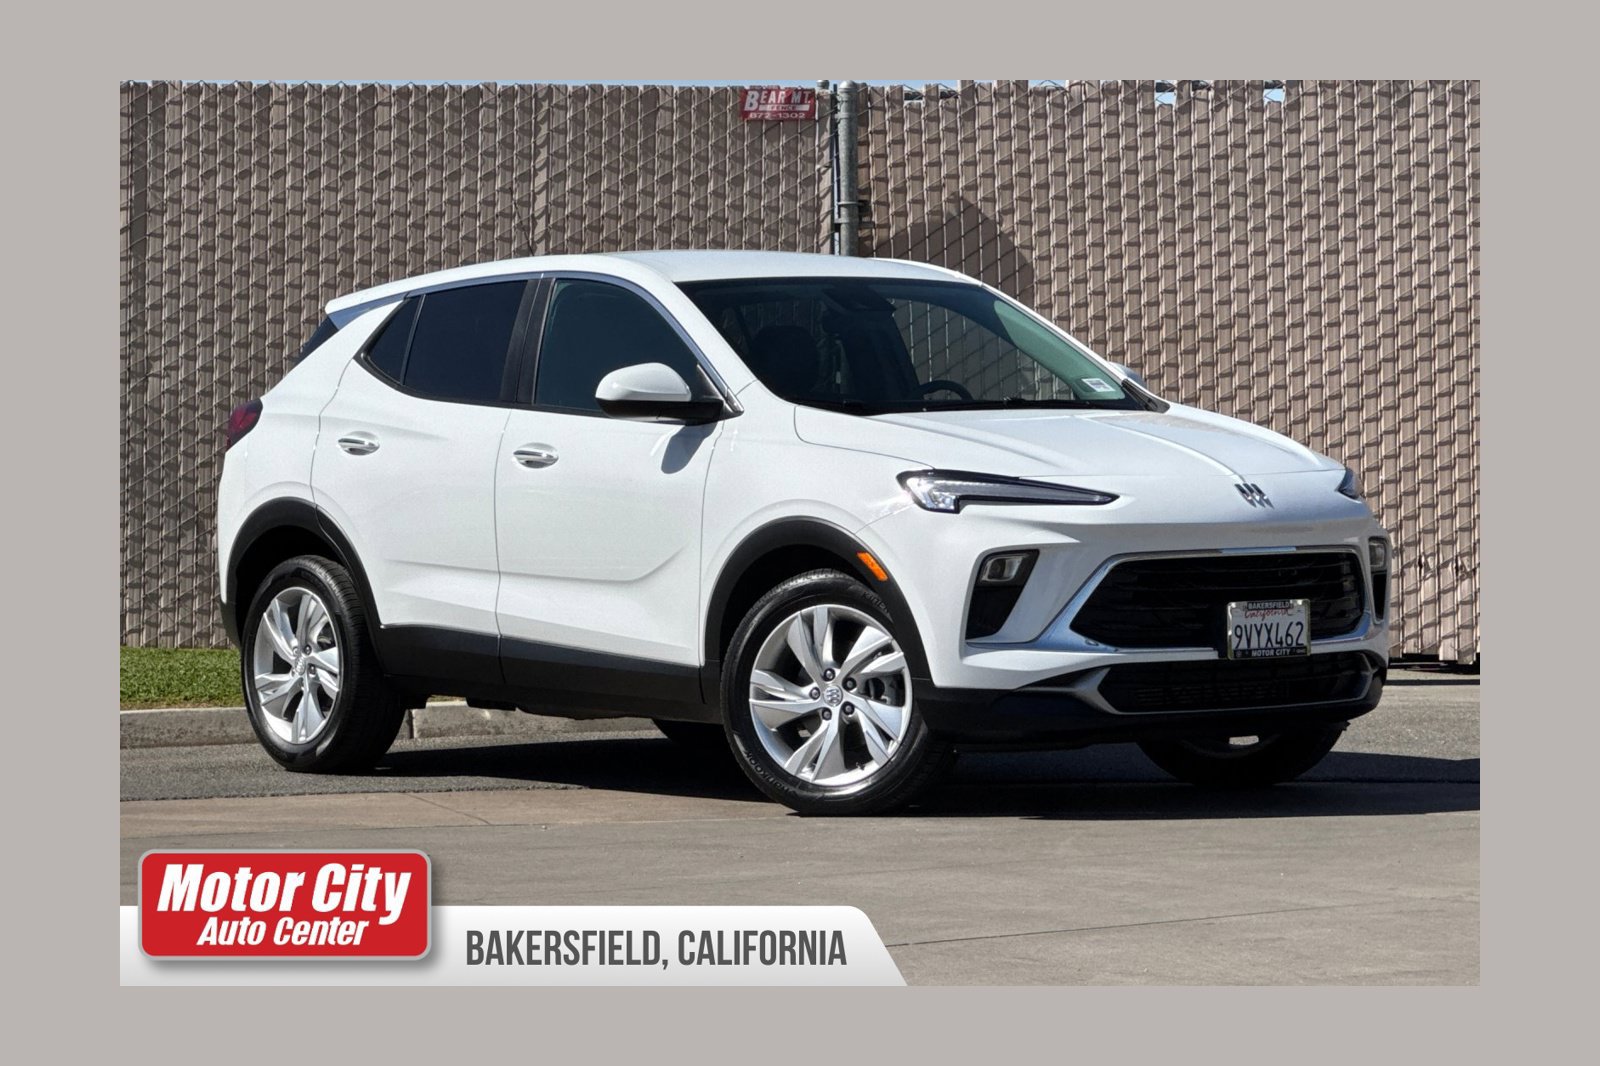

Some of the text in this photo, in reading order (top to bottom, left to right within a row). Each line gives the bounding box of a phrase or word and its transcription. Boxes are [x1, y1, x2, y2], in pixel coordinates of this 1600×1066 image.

[744, 90, 811, 111] BEAR MT.
[1248, 601, 1290, 610] BAKERSFIELD
[1234, 621, 1304, 649] 9VYX462
[1252, 648, 1274, 657] MOTOR
[1275, 647, 1291, 656] CITY
